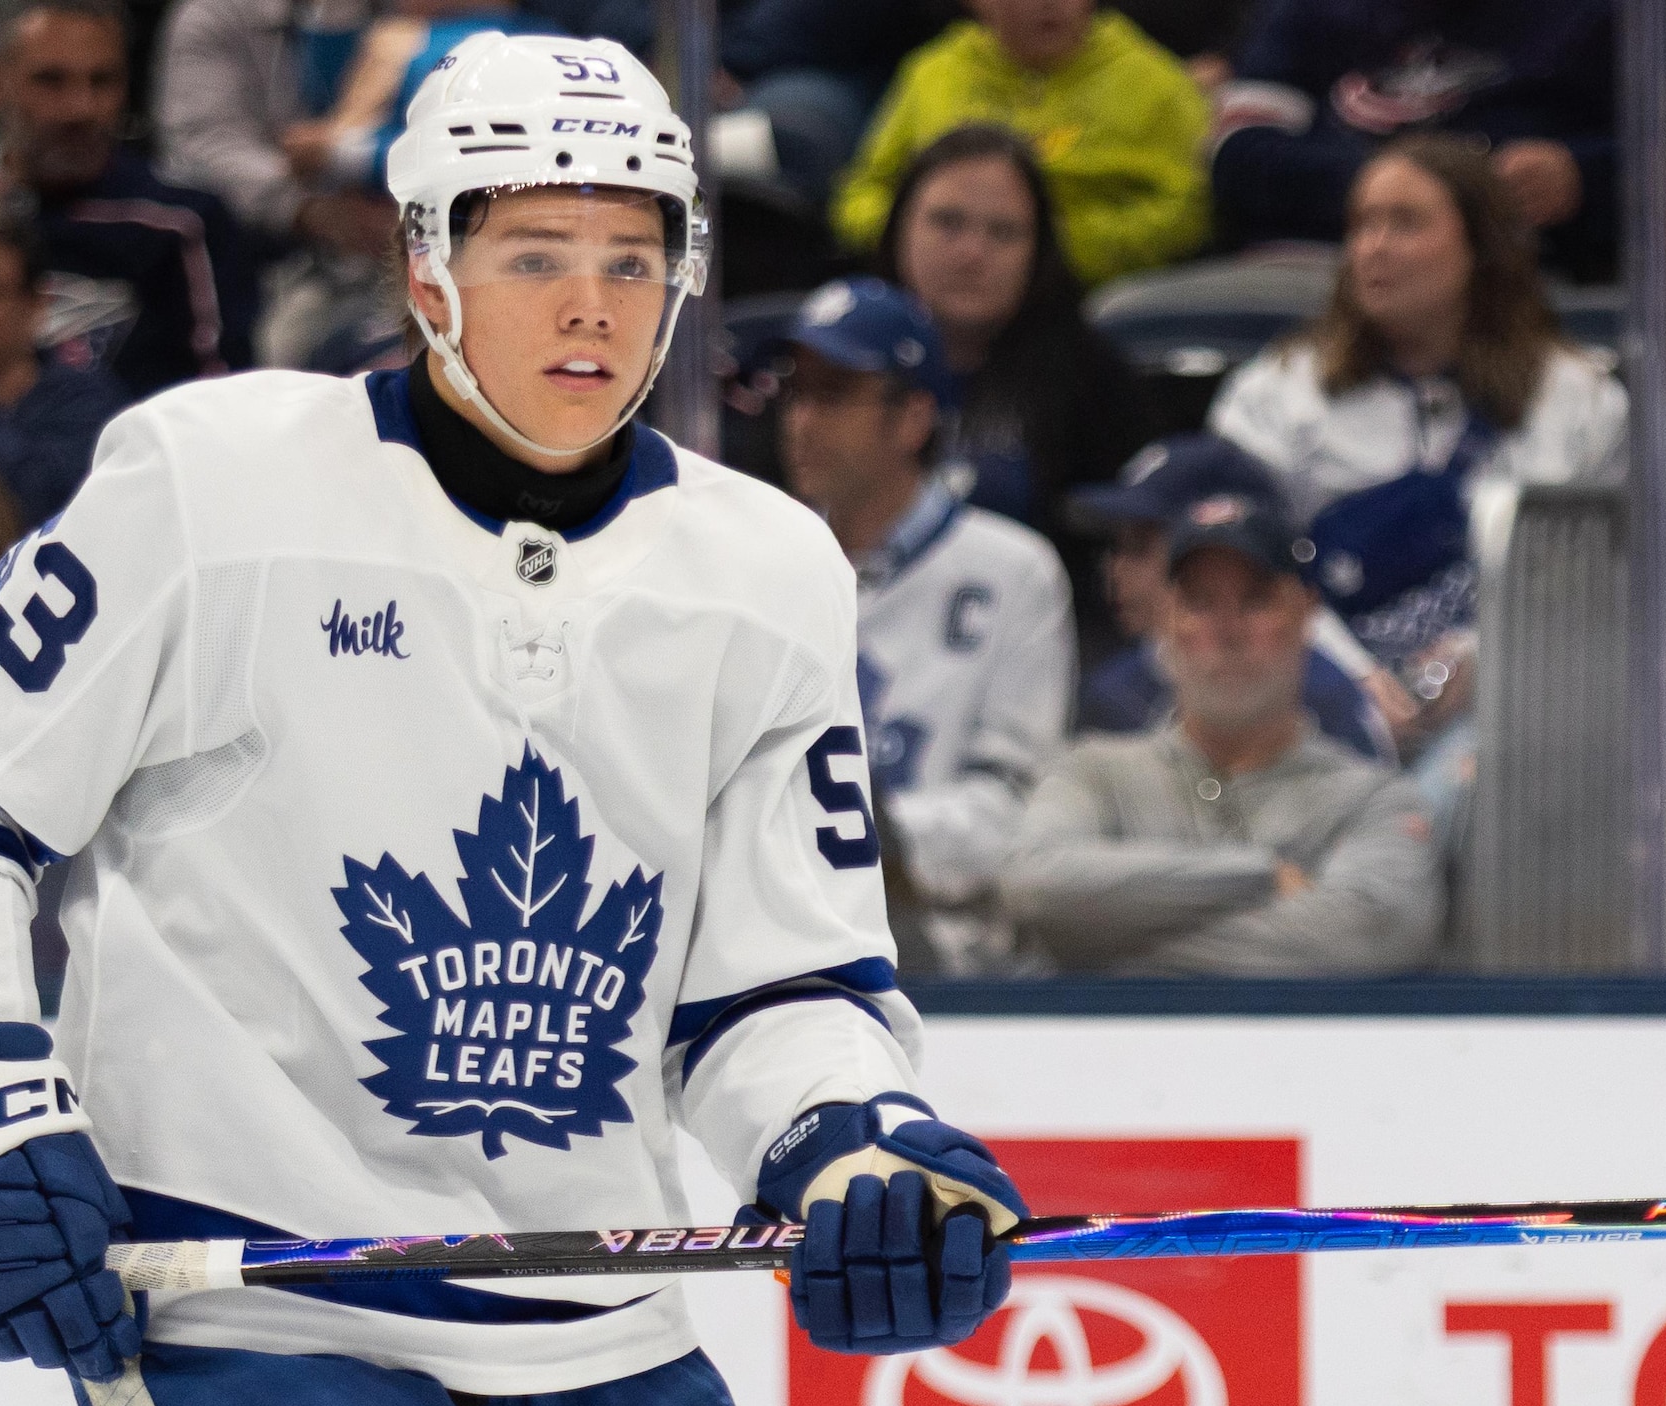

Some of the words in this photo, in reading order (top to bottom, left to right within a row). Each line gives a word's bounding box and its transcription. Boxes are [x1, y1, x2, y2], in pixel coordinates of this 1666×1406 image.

[551, 54, 621, 84] 53
[551, 118, 643, 138] CCM
[523, 551, 552, 576] NHL
[320, 598, 411, 660] Milk
[944, 580, 994, 653] C
[397, 939, 627, 1012] TORONTO
[434, 997, 593, 1044] MAPLE
[425, 1043, 586, 1089] LEAFS
[769, 1112, 820, 1161] CCM
[636, 1225, 807, 1252] BAUE
[1542, 1232, 1644, 1245] BAUER
[501, 1267, 555, 1276] TWITCH
[561, 1265, 606, 1274] TAPER
[611, 1263, 706, 1273] TECHNOLOGY
